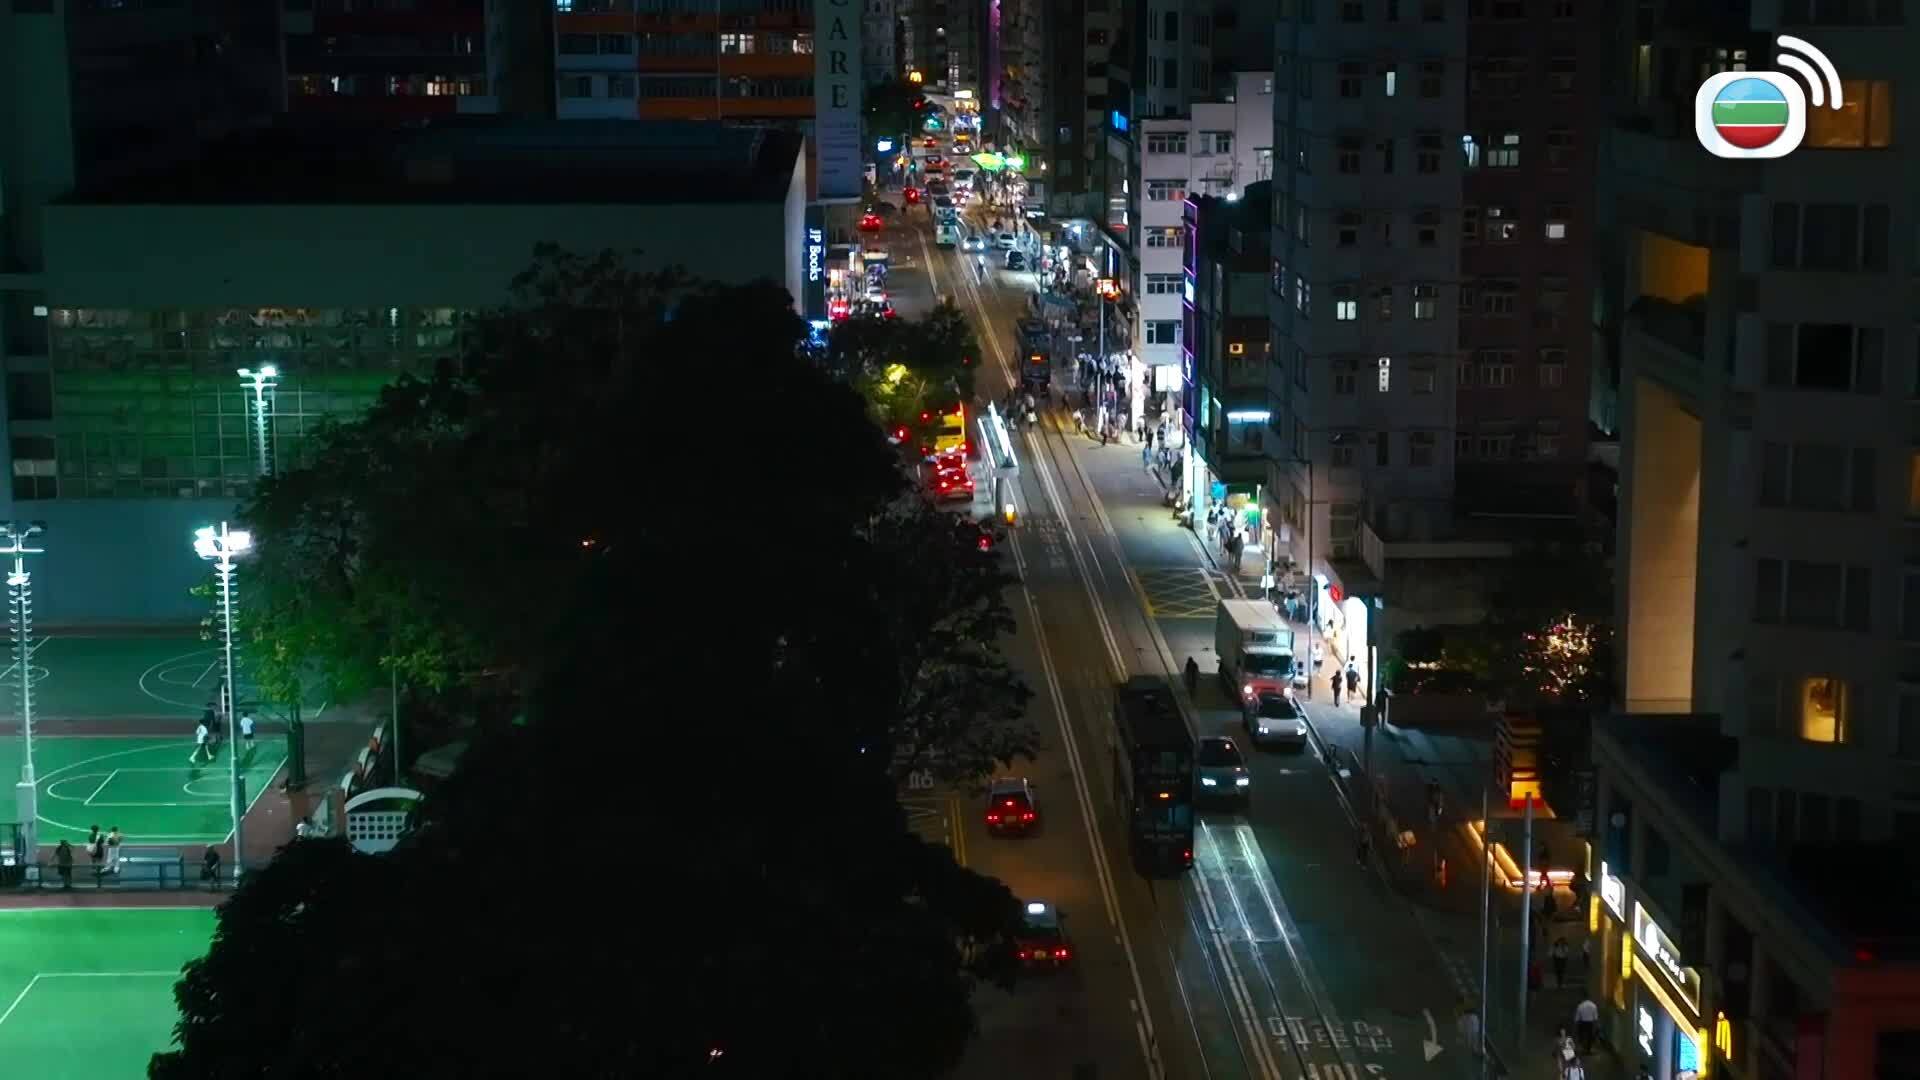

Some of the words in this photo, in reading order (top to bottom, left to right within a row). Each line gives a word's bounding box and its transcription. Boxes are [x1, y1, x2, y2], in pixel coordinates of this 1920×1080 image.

[829, 0, 849, 108] ARE
[809, 228, 822, 242] JP
[809, 245, 822, 282] Books
